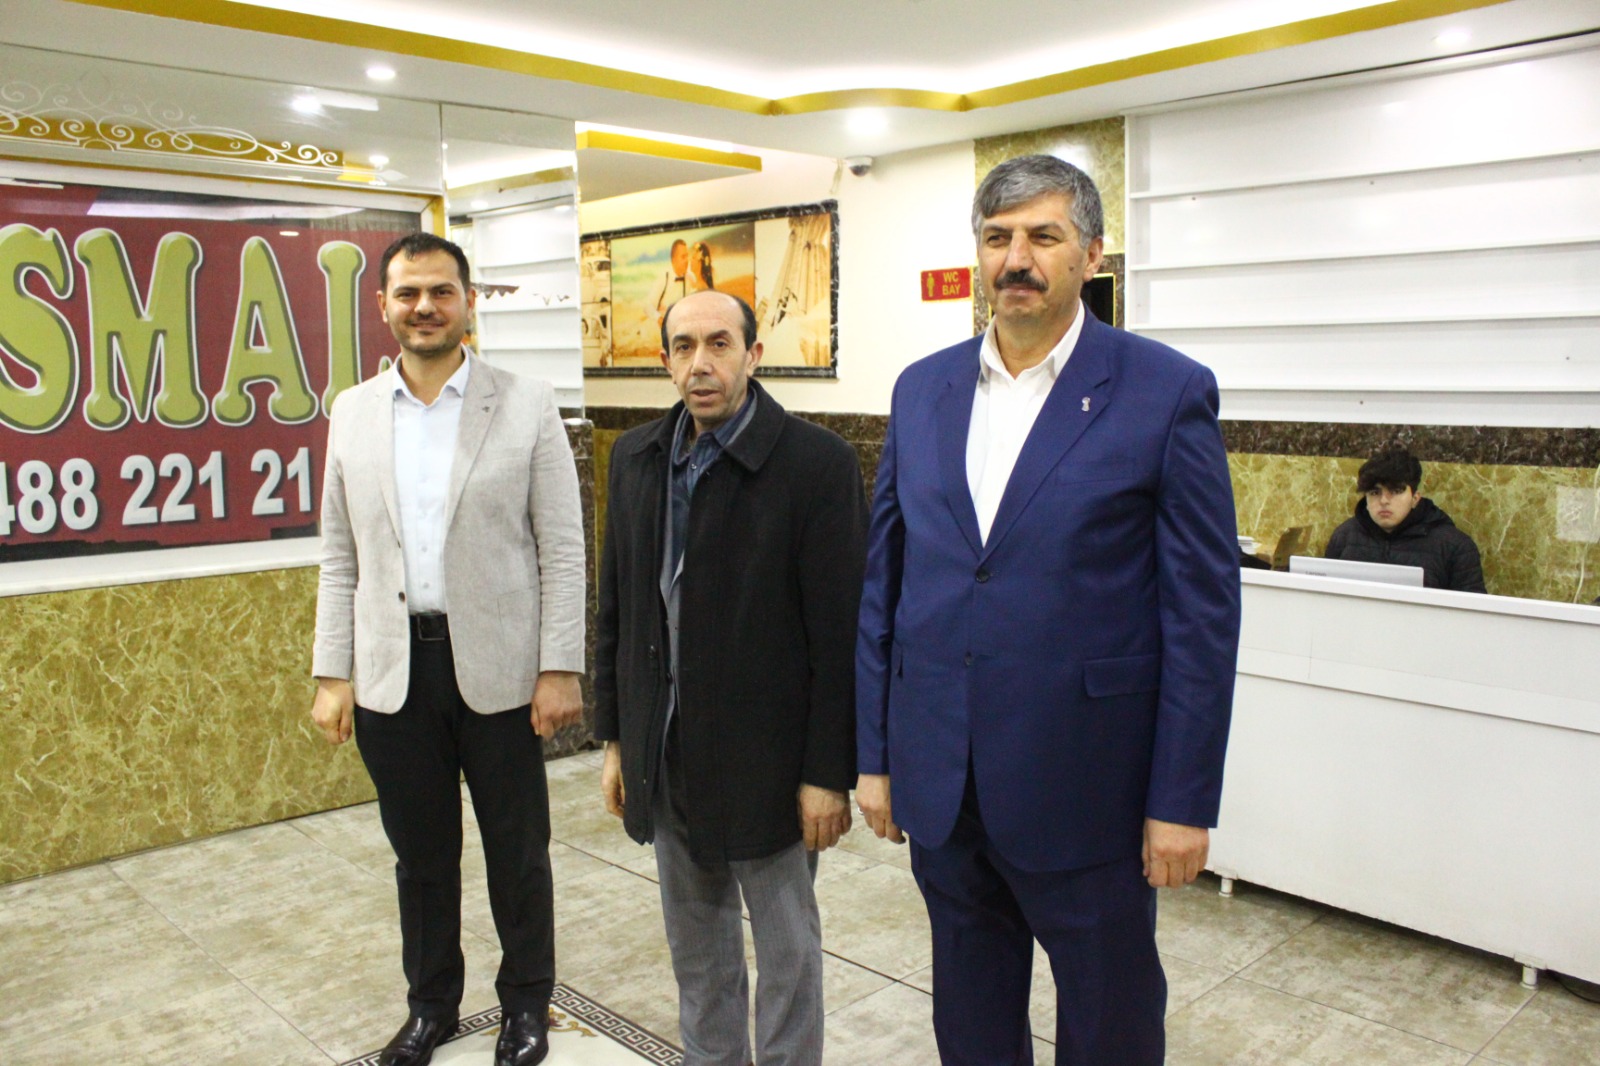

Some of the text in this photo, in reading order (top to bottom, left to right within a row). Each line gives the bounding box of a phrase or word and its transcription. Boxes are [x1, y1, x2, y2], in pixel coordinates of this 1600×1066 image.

[943, 271, 959, 283] WC
[942, 284, 961, 296] BAY
[119, 451, 225, 526] 221
[251, 446, 311, 516] 21
